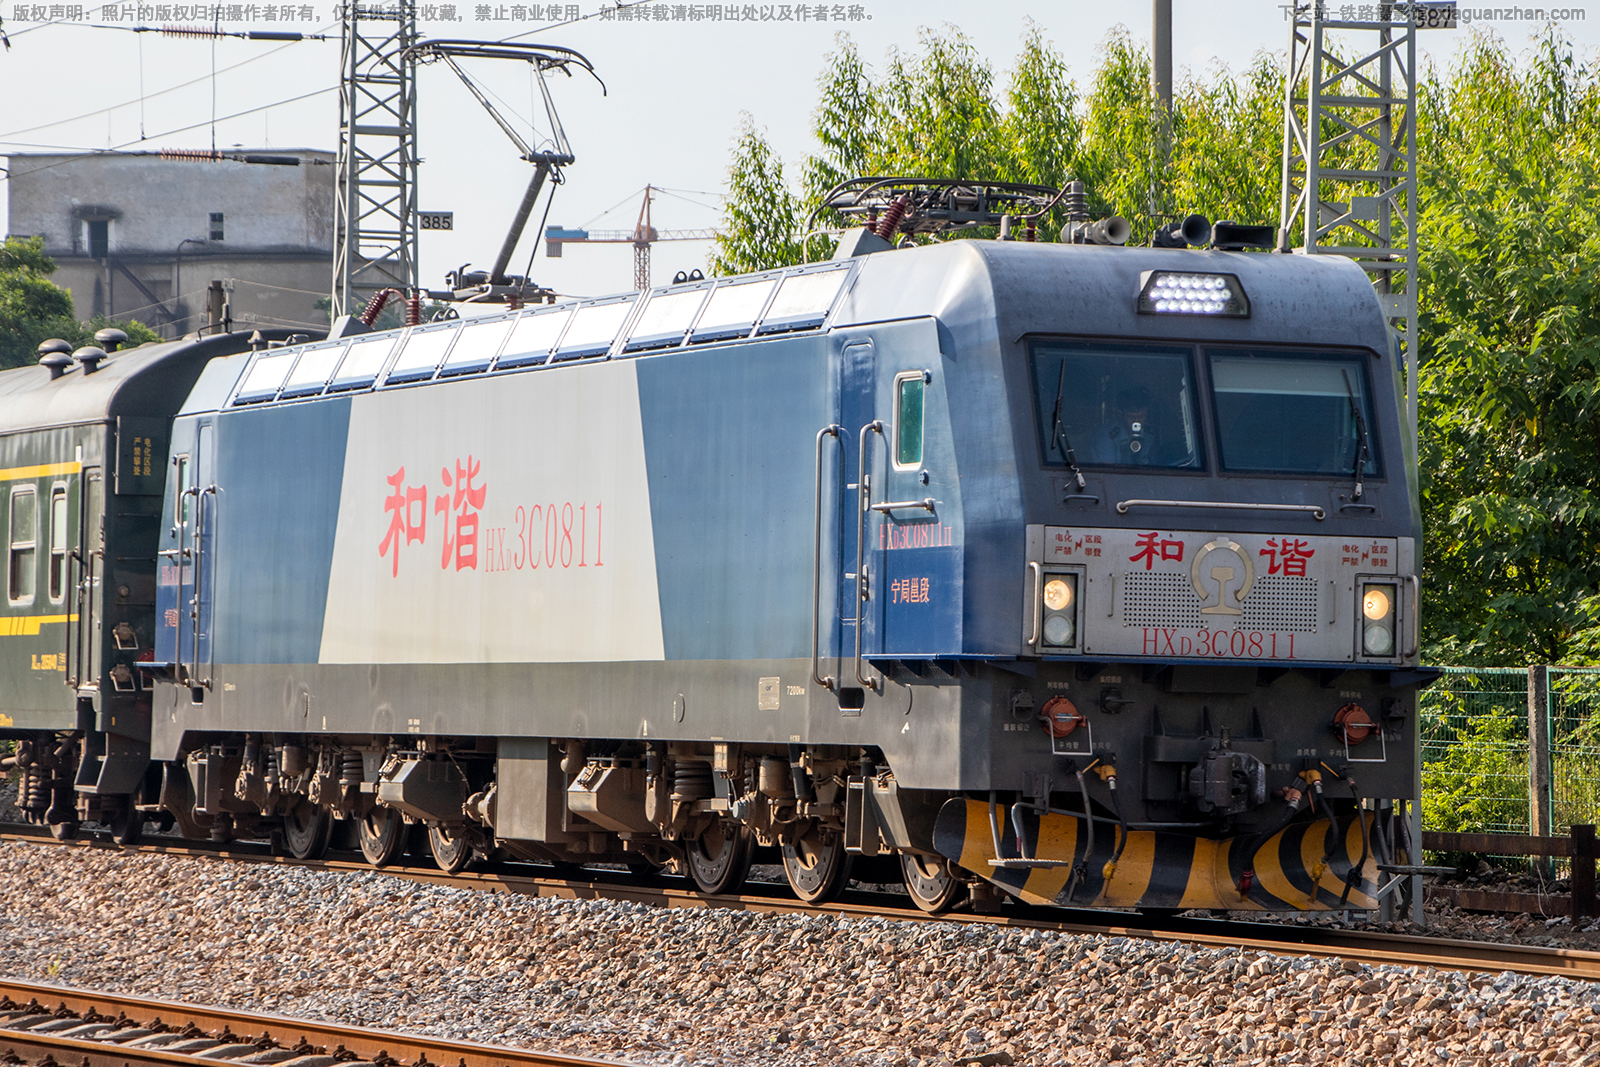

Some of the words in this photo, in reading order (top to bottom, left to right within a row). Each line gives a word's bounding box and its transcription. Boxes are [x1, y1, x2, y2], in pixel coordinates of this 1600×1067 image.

[422, 216, 451, 229] 385
[378, 454, 487, 578] 和谐
[1129, 531, 1184, 570] 和
[1259, 538, 1316, 577] 谐
[891, 577, 930, 604] 宁局邕段
[1141, 628, 1297, 659] HXD3C0811
